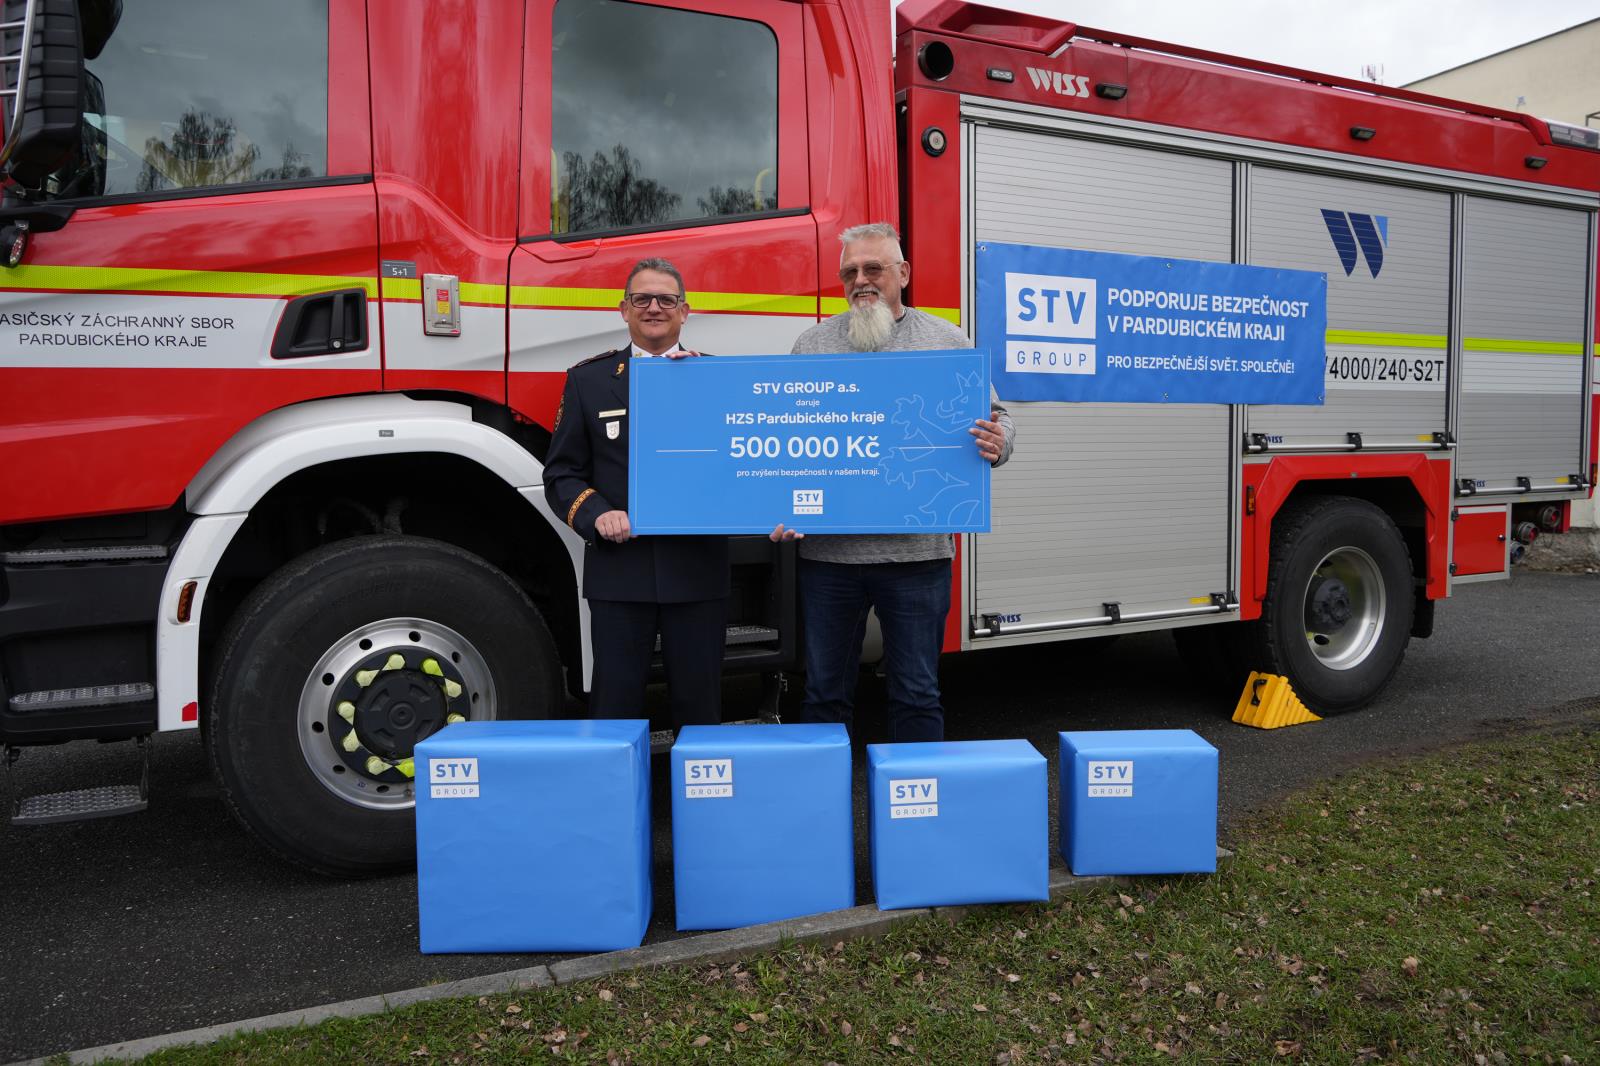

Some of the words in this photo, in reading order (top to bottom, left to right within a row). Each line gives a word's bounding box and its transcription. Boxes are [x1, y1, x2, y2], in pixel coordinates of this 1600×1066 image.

[1025, 66, 1090, 99] WISS
[392, 267, 408, 276] 5+1
[1017, 287, 1087, 325] STV
[1107, 287, 1208, 312] PODPORUJE
[1212, 295, 1309, 318] BEZPEČNOST
[0, 311, 75, 326] ASIČSKÝ
[81, 313, 185, 329] ZÁCHRANNÝ
[190, 317, 235, 329] SBOR
[1107, 315, 1119, 333] V
[1122, 316, 1241, 339] PARDUBICKÉM
[1244, 323, 1285, 341] KRAJI
[19, 332, 150, 347] PARDUBICKÉHO
[154, 335, 208, 347] KRAJE
[1016, 350, 1087, 367] GROUP
[1106, 355, 1132, 369] PRO
[1134, 355, 1209, 371] BEZPEČNĚJŠÍ
[1209, 356, 1239, 372] SVĚT.
[1241, 358, 1295, 374] SPOLEČNĚ!
[752, 382, 781, 394] STV
[783, 381, 835, 394] GROUP
[837, 383, 860, 393] a.s.
[795, 399, 821, 408] daruje
[725, 413, 754, 425] HZS
[757, 411, 849, 424] Pardubického
[851, 411, 885, 425] kraje
[729, 436, 781, 458] 500
[787, 436, 839, 458] 000
[846, 435, 881, 458] Kč
[736, 470, 750, 478] pro
[751, 468, 779, 478] zvýšení
[780, 468, 828, 478] bezpečnosti
[834, 468, 860, 476] našem
[861, 467, 880, 477] kraji.
[796, 493, 820, 503] STV
[434, 763, 473, 778] STV
[690, 764, 727, 779] STV
[1093, 766, 1128, 779] STV
[435, 788, 475, 796] GROUP
[690, 788, 728, 796] GROUP
[895, 784, 932, 799] STV
[895, 807, 934, 816] GROUP
